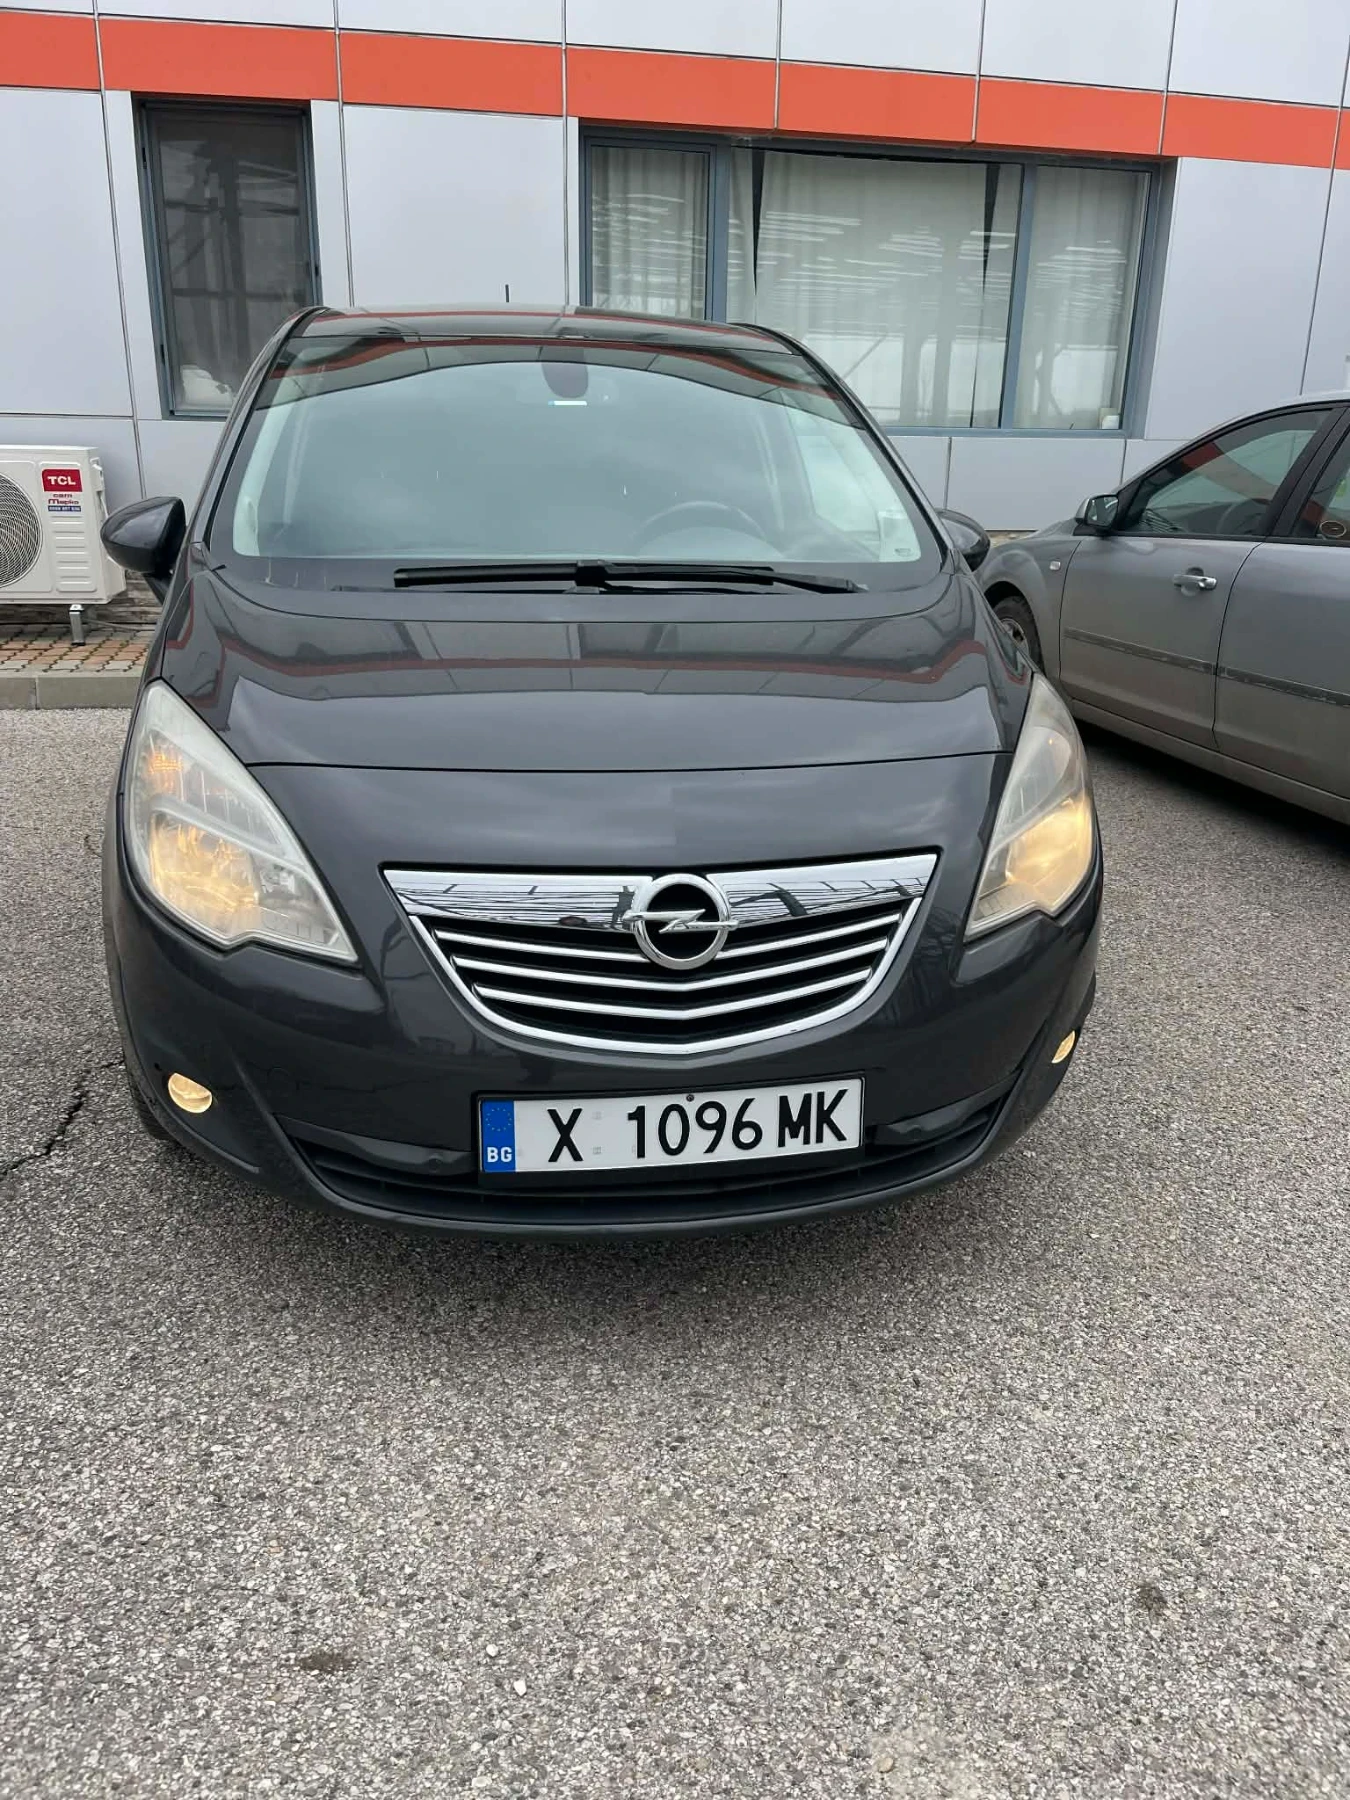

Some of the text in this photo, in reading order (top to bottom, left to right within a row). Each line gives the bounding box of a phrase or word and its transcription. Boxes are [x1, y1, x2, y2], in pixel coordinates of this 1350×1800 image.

[47, 475, 76, 485] TCL
[547, 1088, 849, 1163] X 1096 MK
[487, 1146, 513, 1163] BG
